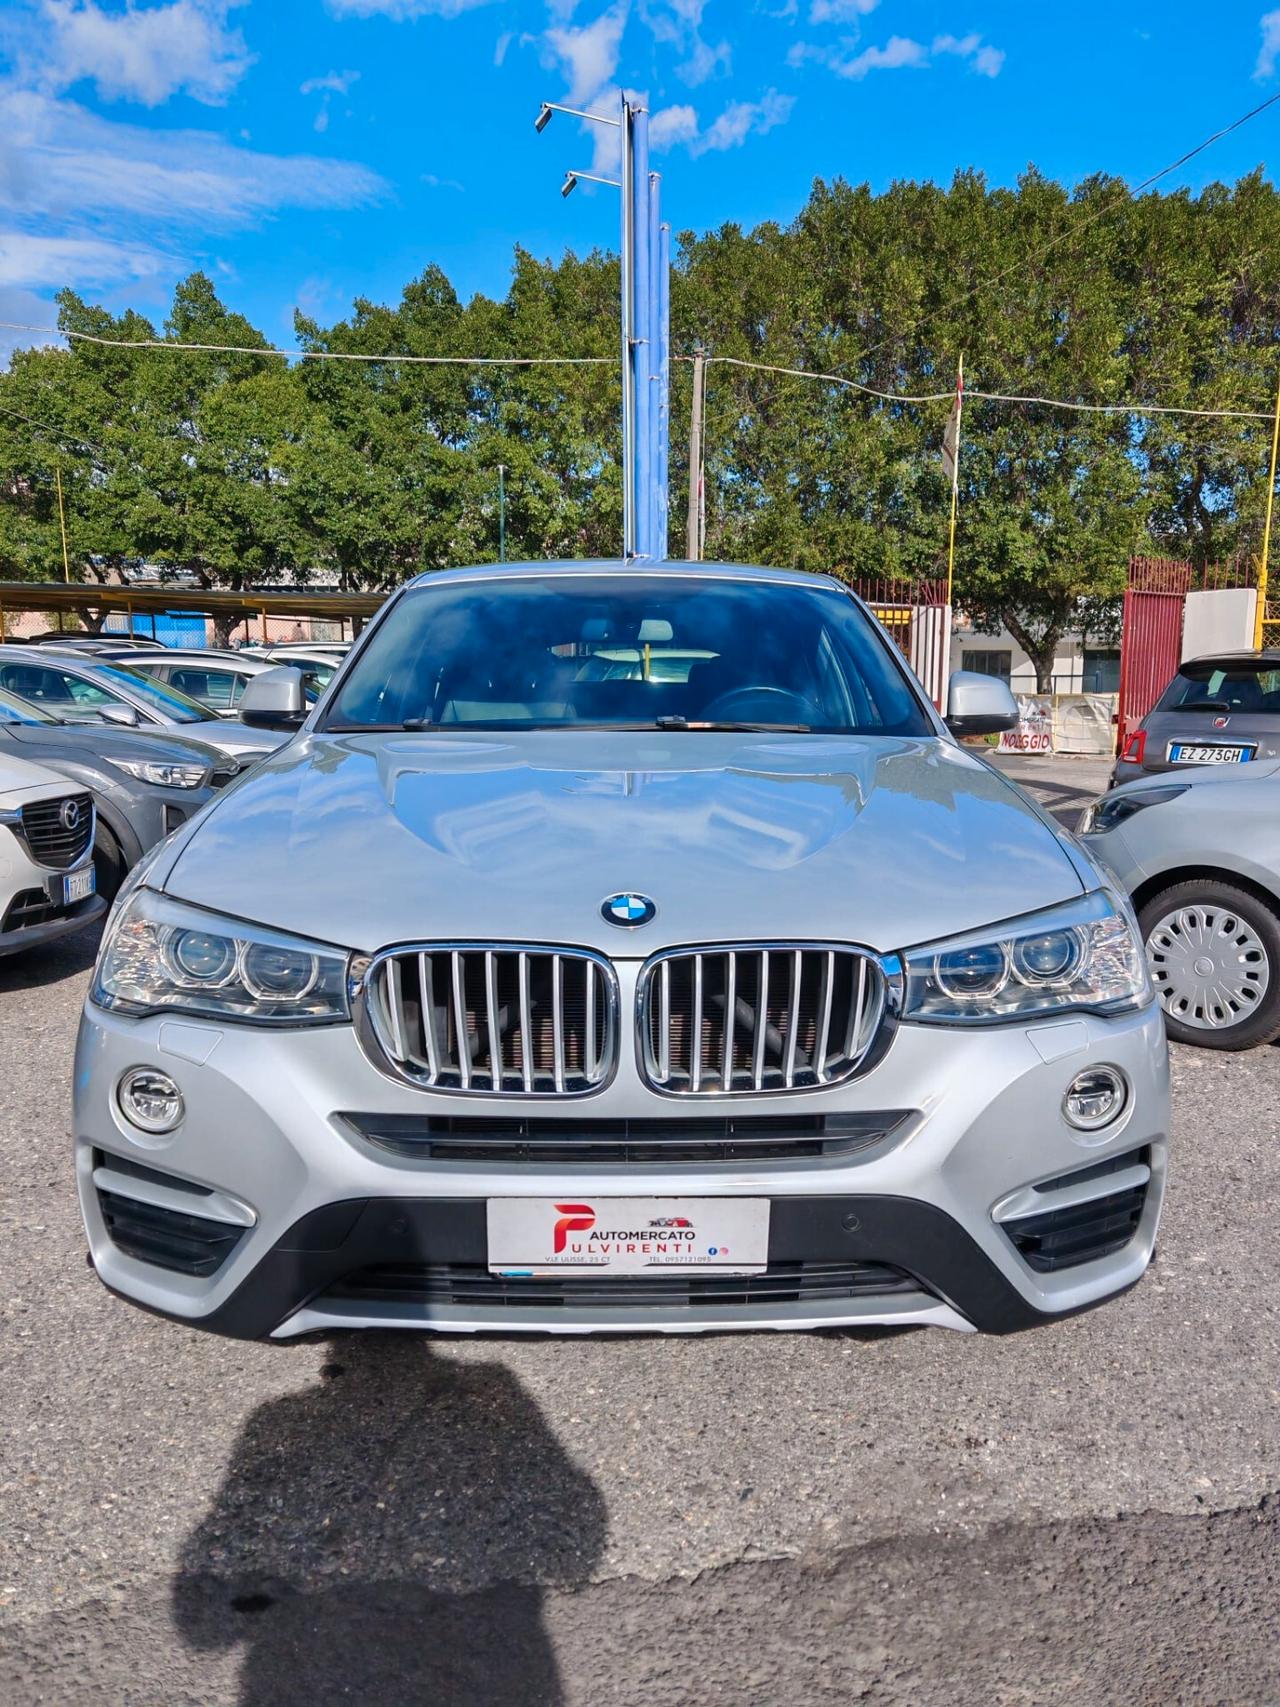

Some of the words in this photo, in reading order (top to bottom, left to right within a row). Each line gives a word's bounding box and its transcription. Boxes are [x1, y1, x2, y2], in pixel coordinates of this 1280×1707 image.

[1179, 747, 1197, 760] EZ
[1199, 748, 1241, 762] 273GH
[590, 1231, 696, 1241] AUTOMERCATO
